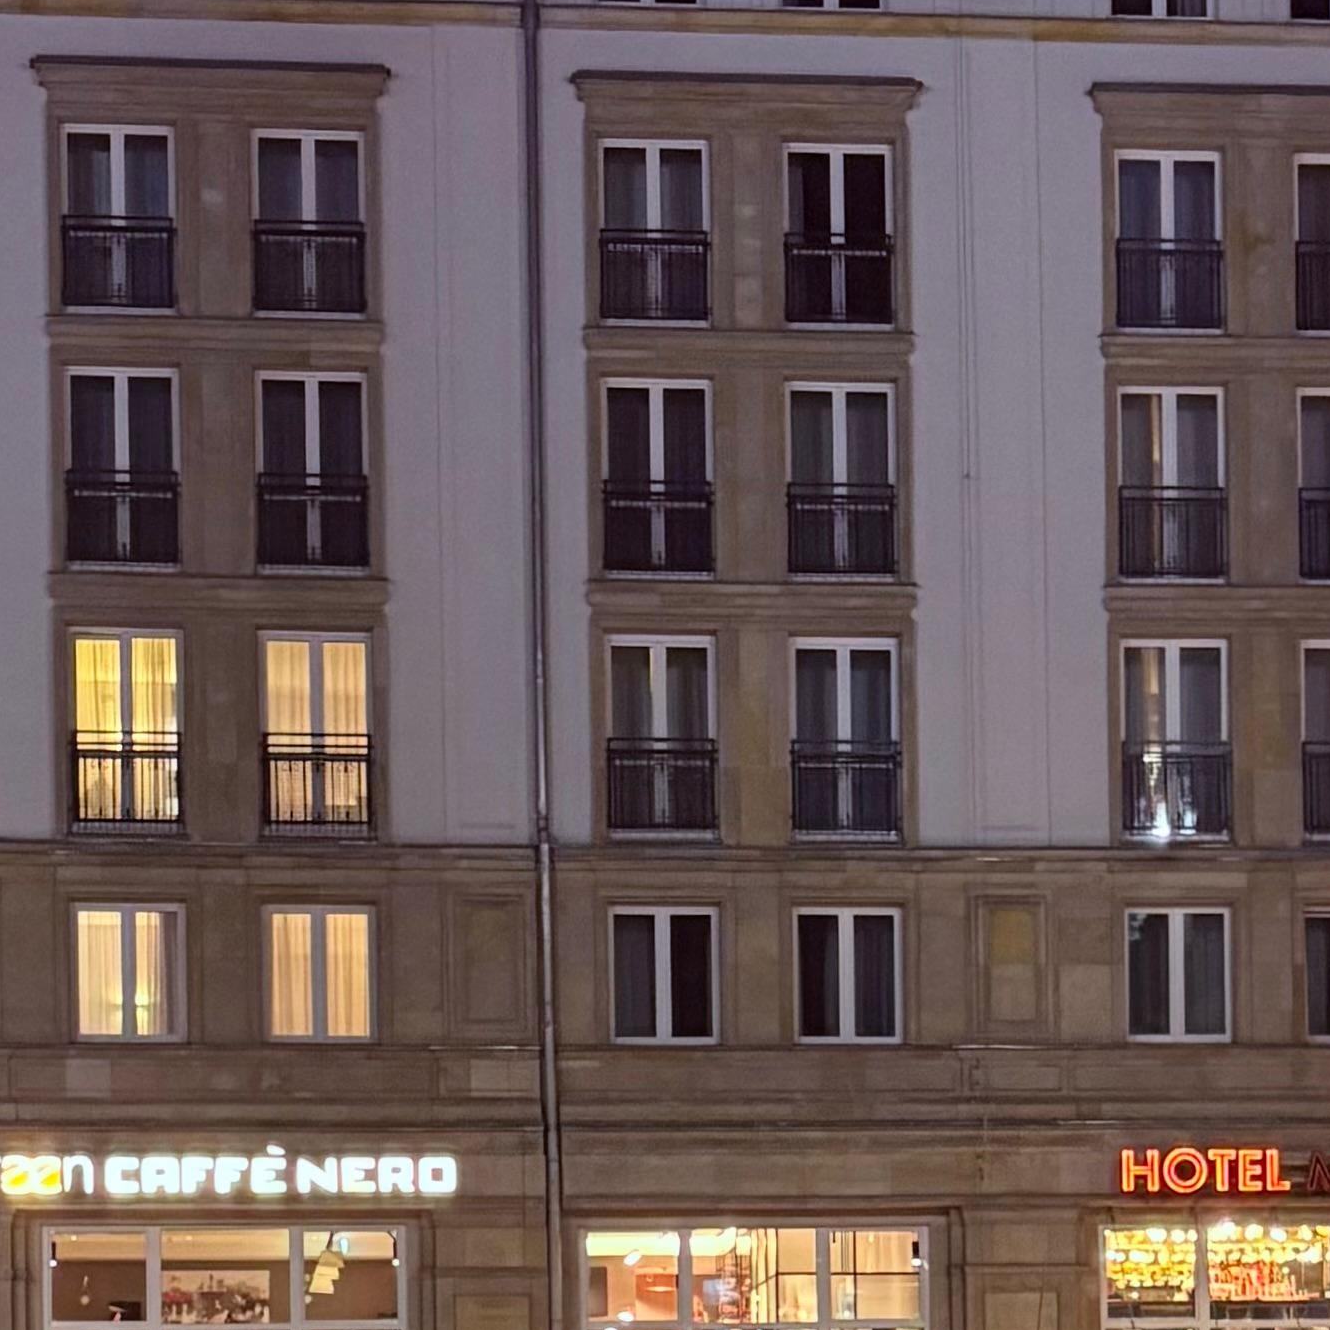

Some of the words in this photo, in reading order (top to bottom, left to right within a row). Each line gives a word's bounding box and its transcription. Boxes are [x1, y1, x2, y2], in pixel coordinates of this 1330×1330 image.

[104, 1145, 288, 1195] CAFFÈ
[295, 1155, 458, 1195] NERO
[1120, 1146, 1291, 1194] HOTEL
